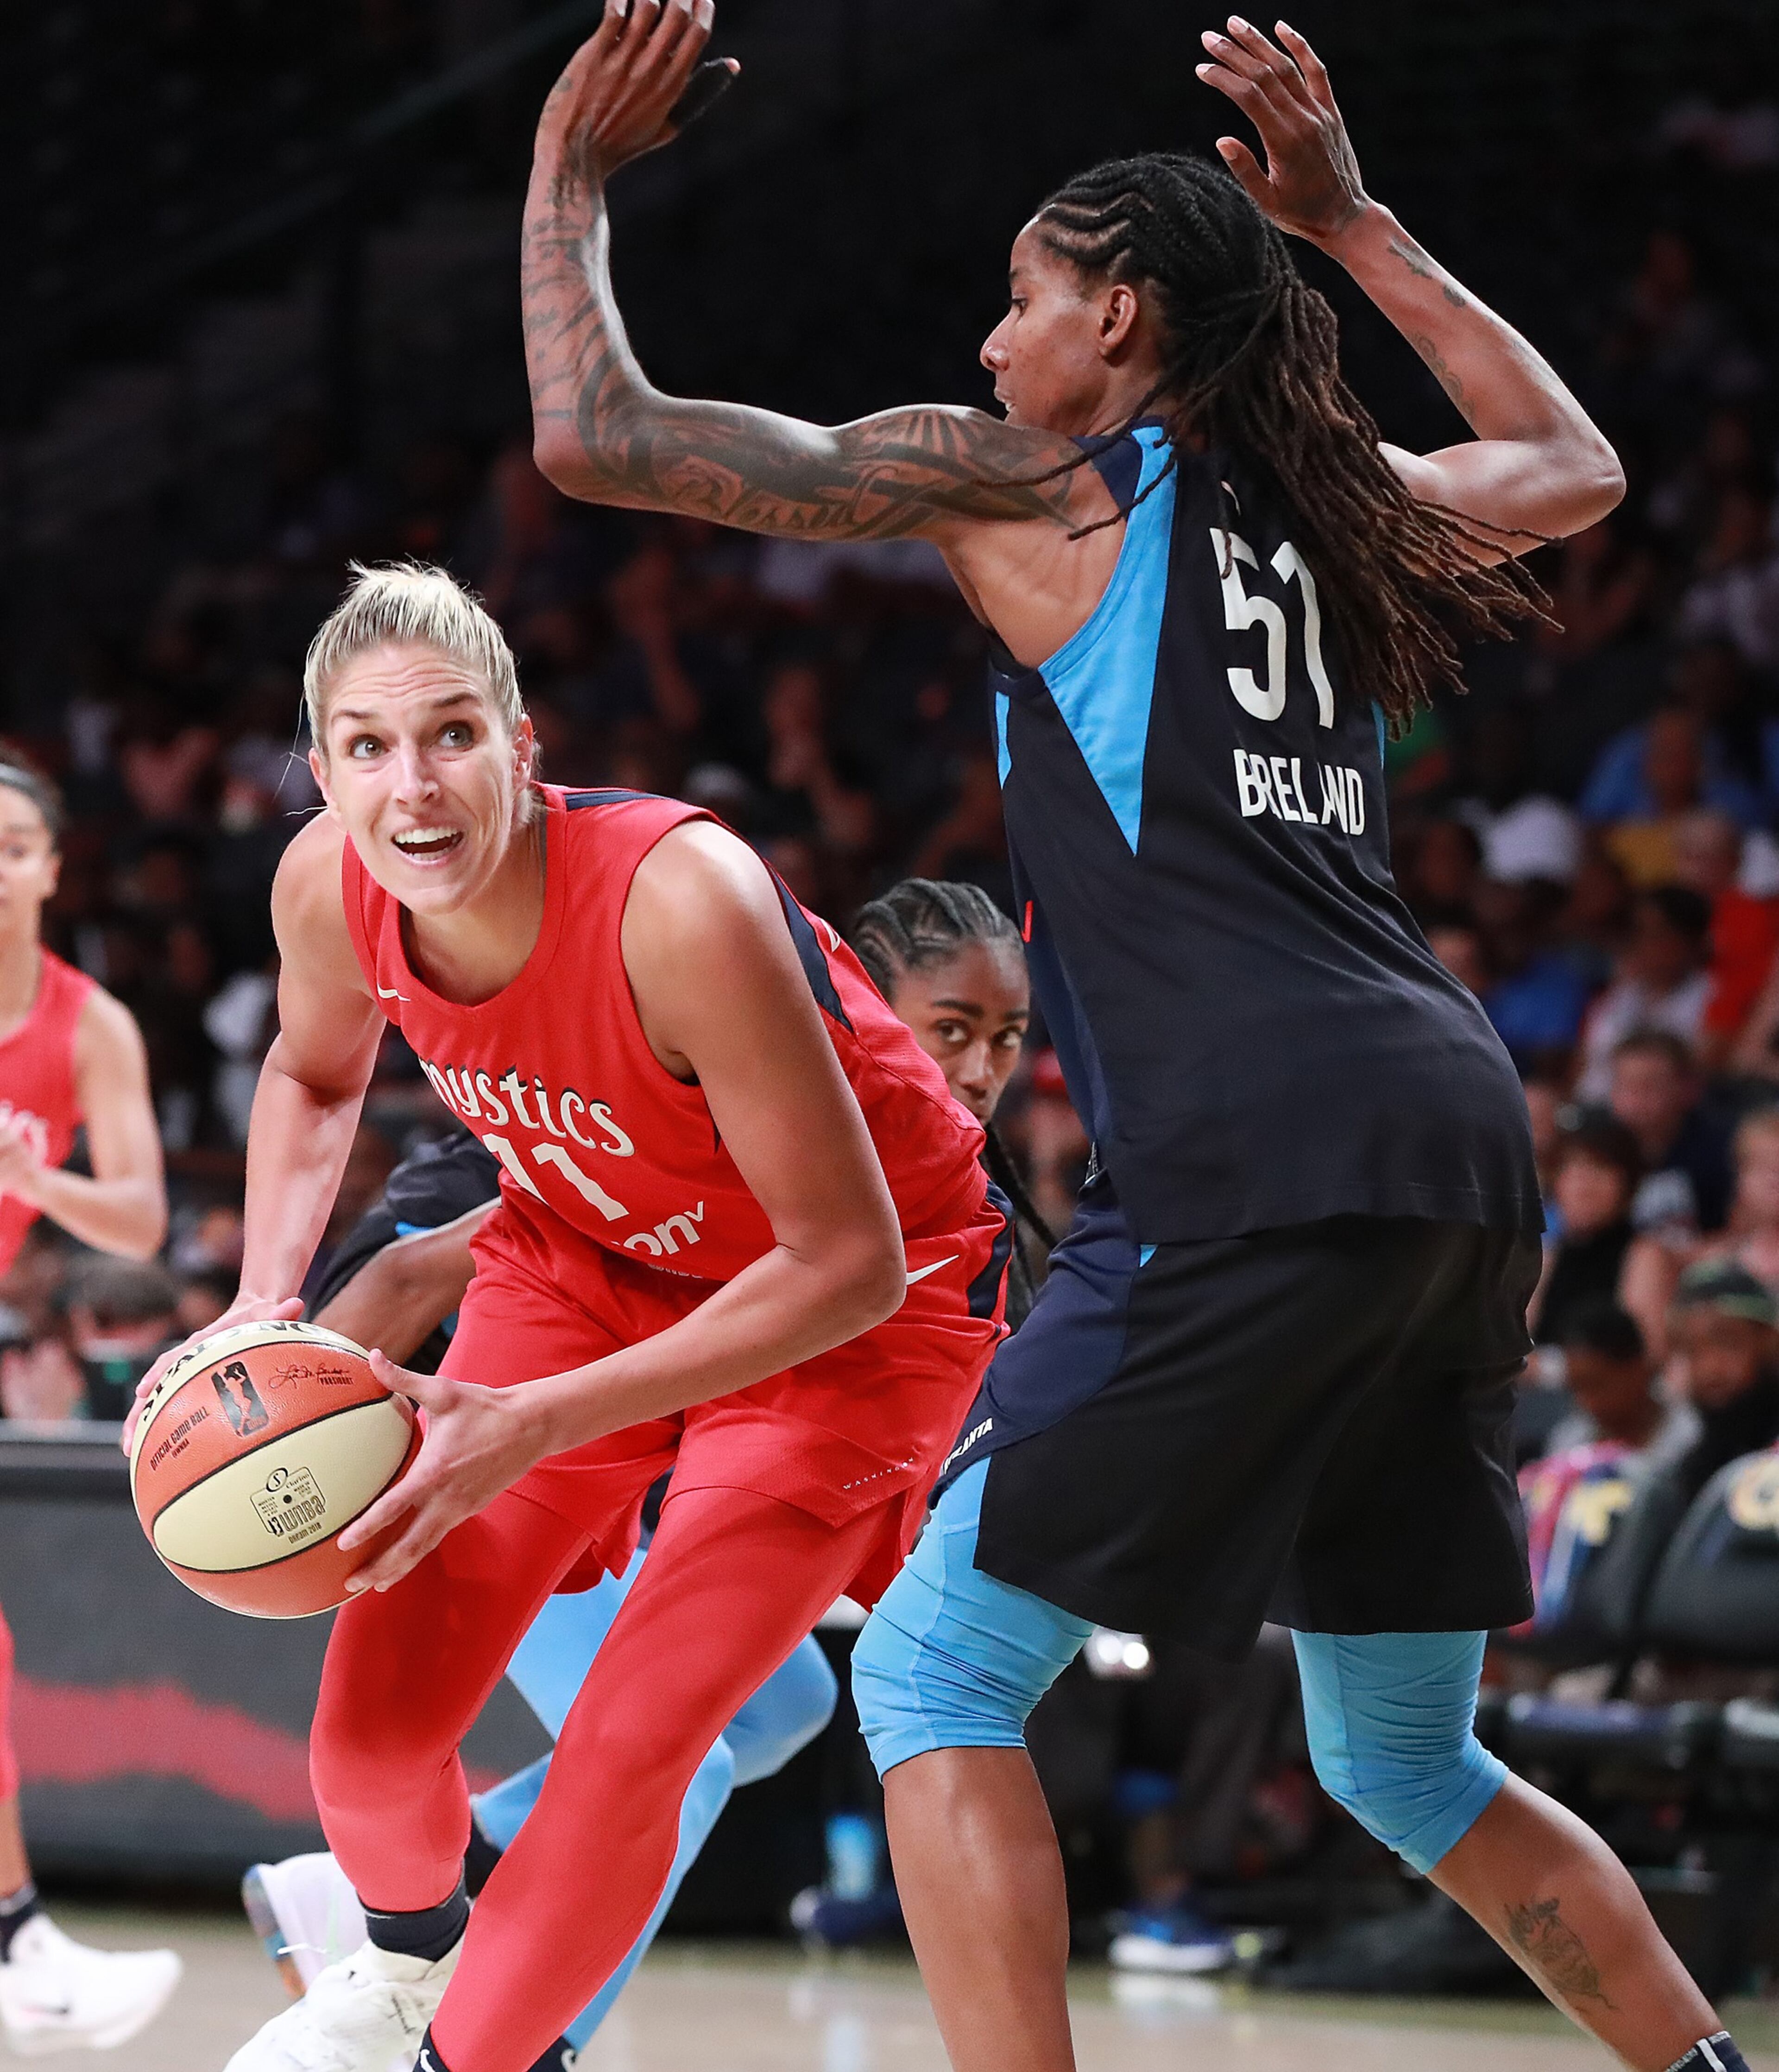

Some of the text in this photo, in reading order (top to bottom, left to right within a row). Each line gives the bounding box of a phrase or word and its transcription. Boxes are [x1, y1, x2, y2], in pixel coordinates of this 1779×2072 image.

[1210, 527, 1335, 730] 51
[1233, 748, 1365, 836] BRELAND
[482, 1133, 629, 1222] 11
